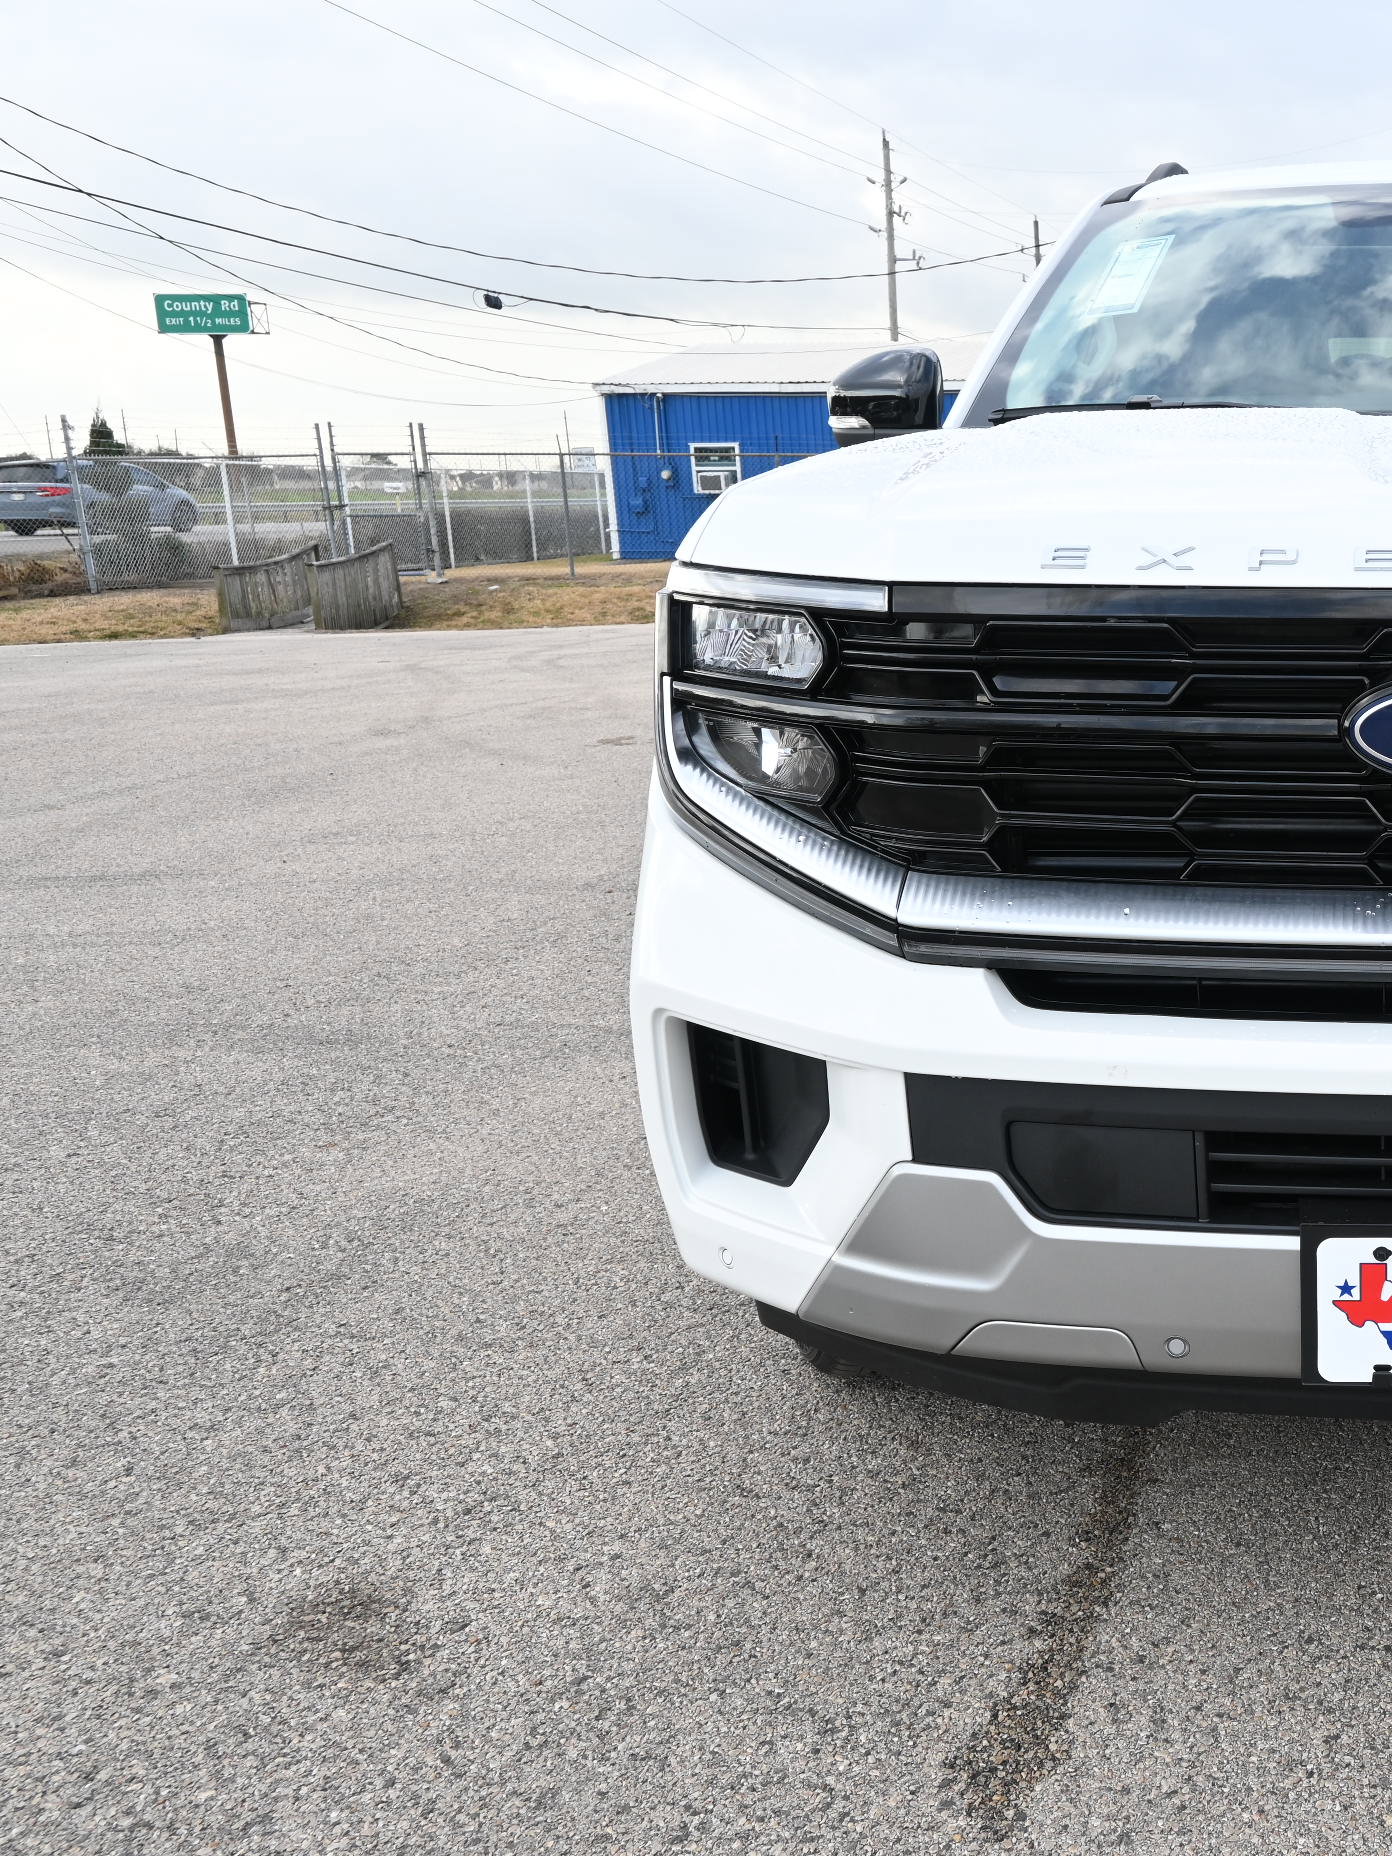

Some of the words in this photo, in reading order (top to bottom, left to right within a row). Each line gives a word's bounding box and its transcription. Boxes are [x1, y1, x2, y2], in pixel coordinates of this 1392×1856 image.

[164, 300, 213, 313] County
[221, 300, 239, 311] Rd
[165, 317, 184, 325] EXIT
[215, 317, 241, 325] MILES
